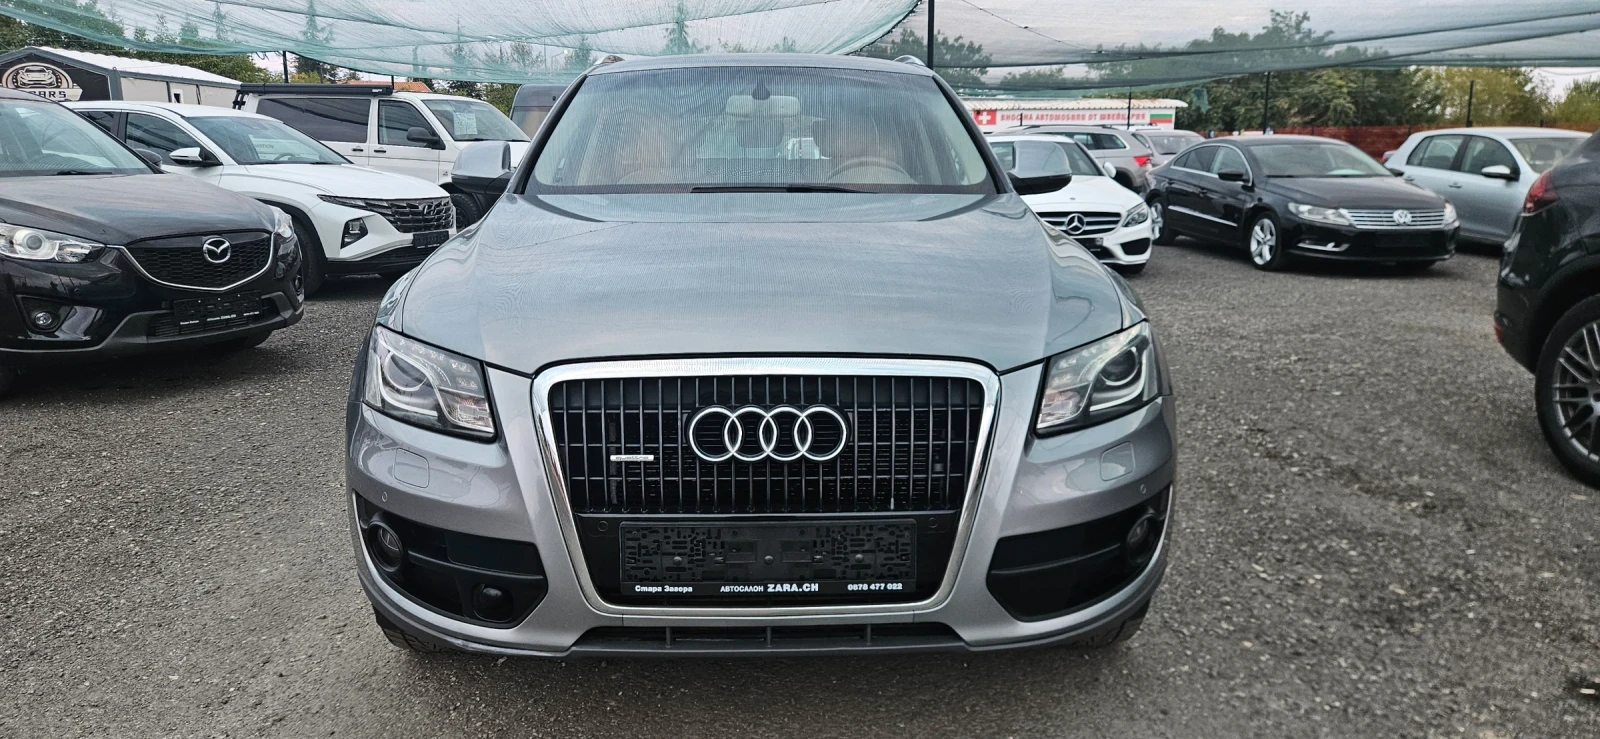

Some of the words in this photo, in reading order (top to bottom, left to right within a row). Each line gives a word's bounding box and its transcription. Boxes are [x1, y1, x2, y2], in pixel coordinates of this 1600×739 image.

[1023, 113, 1033, 121] НА
[1088, 113, 1098, 121] ОТ
[767, 583, 819, 592] ZARA.CH
